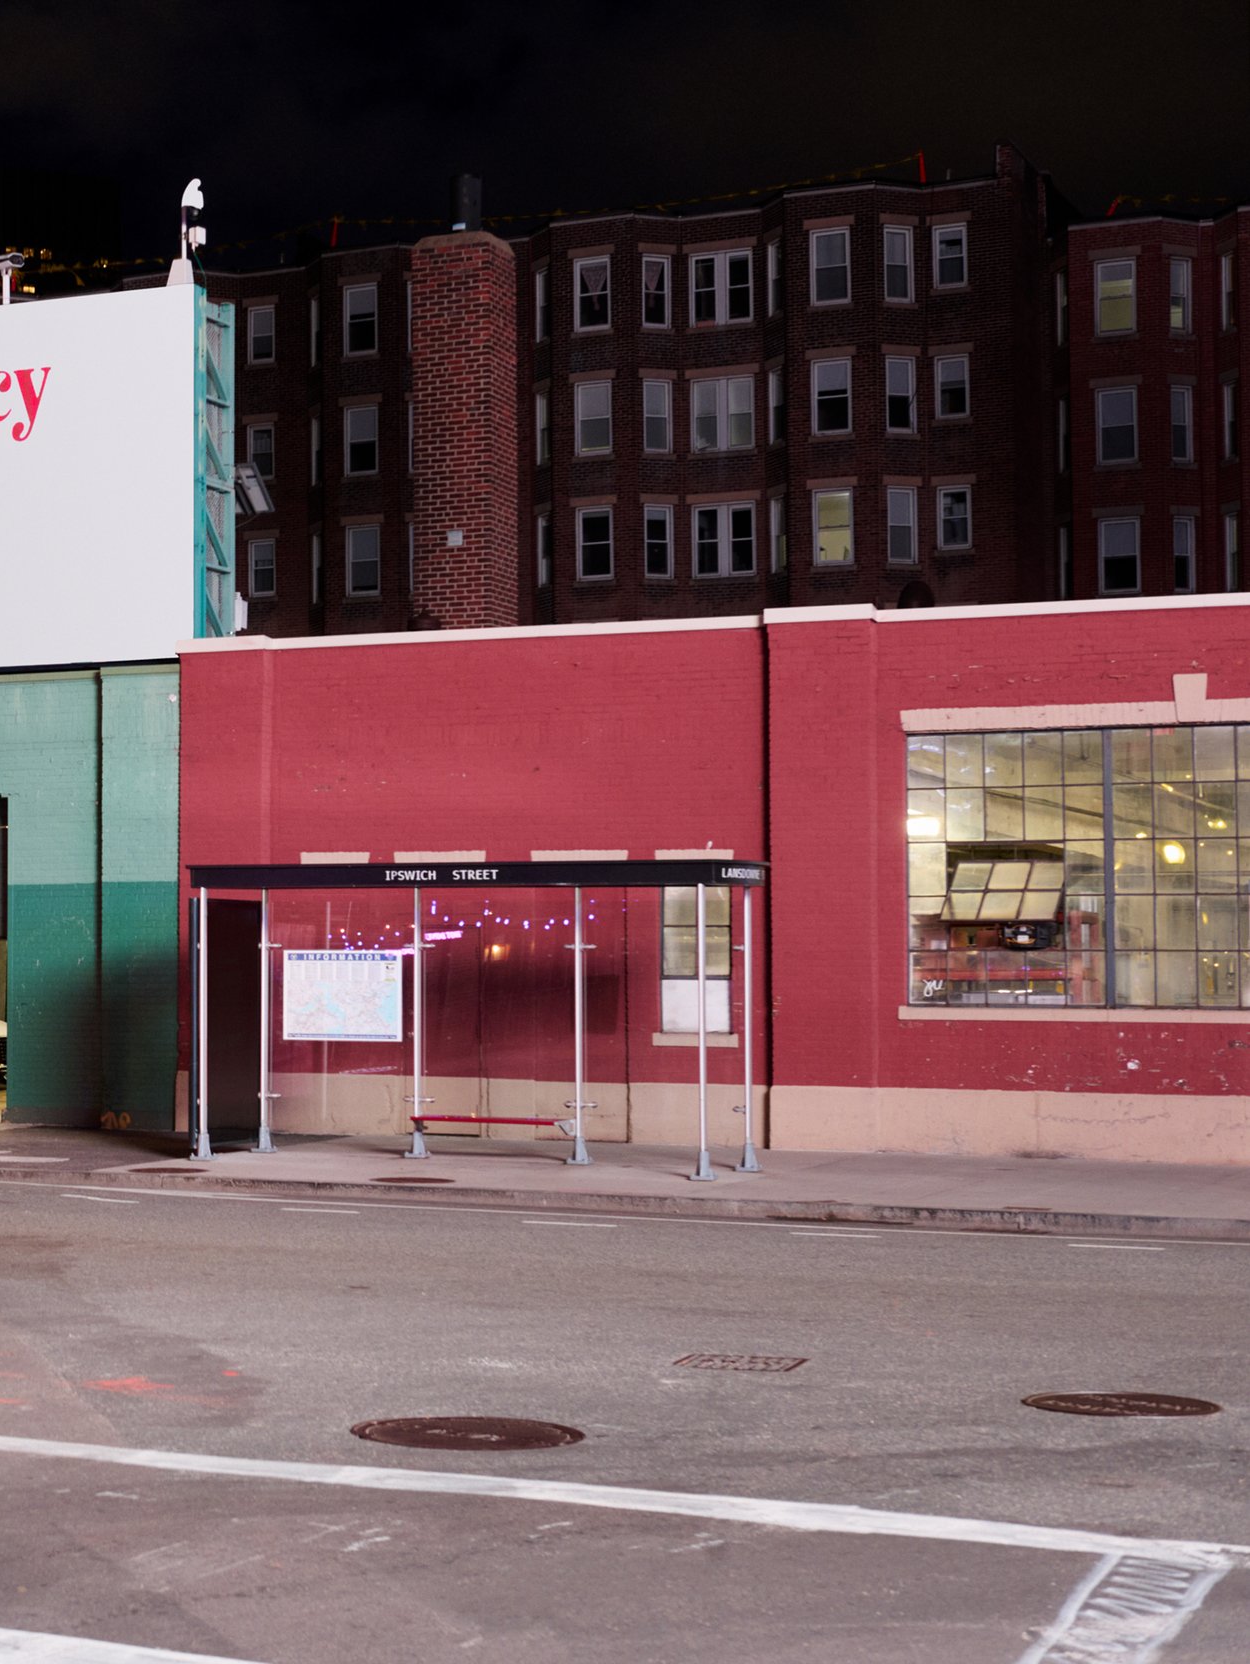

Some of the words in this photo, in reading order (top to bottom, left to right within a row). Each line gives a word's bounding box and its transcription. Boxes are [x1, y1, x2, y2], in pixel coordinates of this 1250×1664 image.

[385, 870, 437, 881] IPSWICH
[452, 869, 499, 880] STREET
[303, 951, 382, 961] INFORMATION
